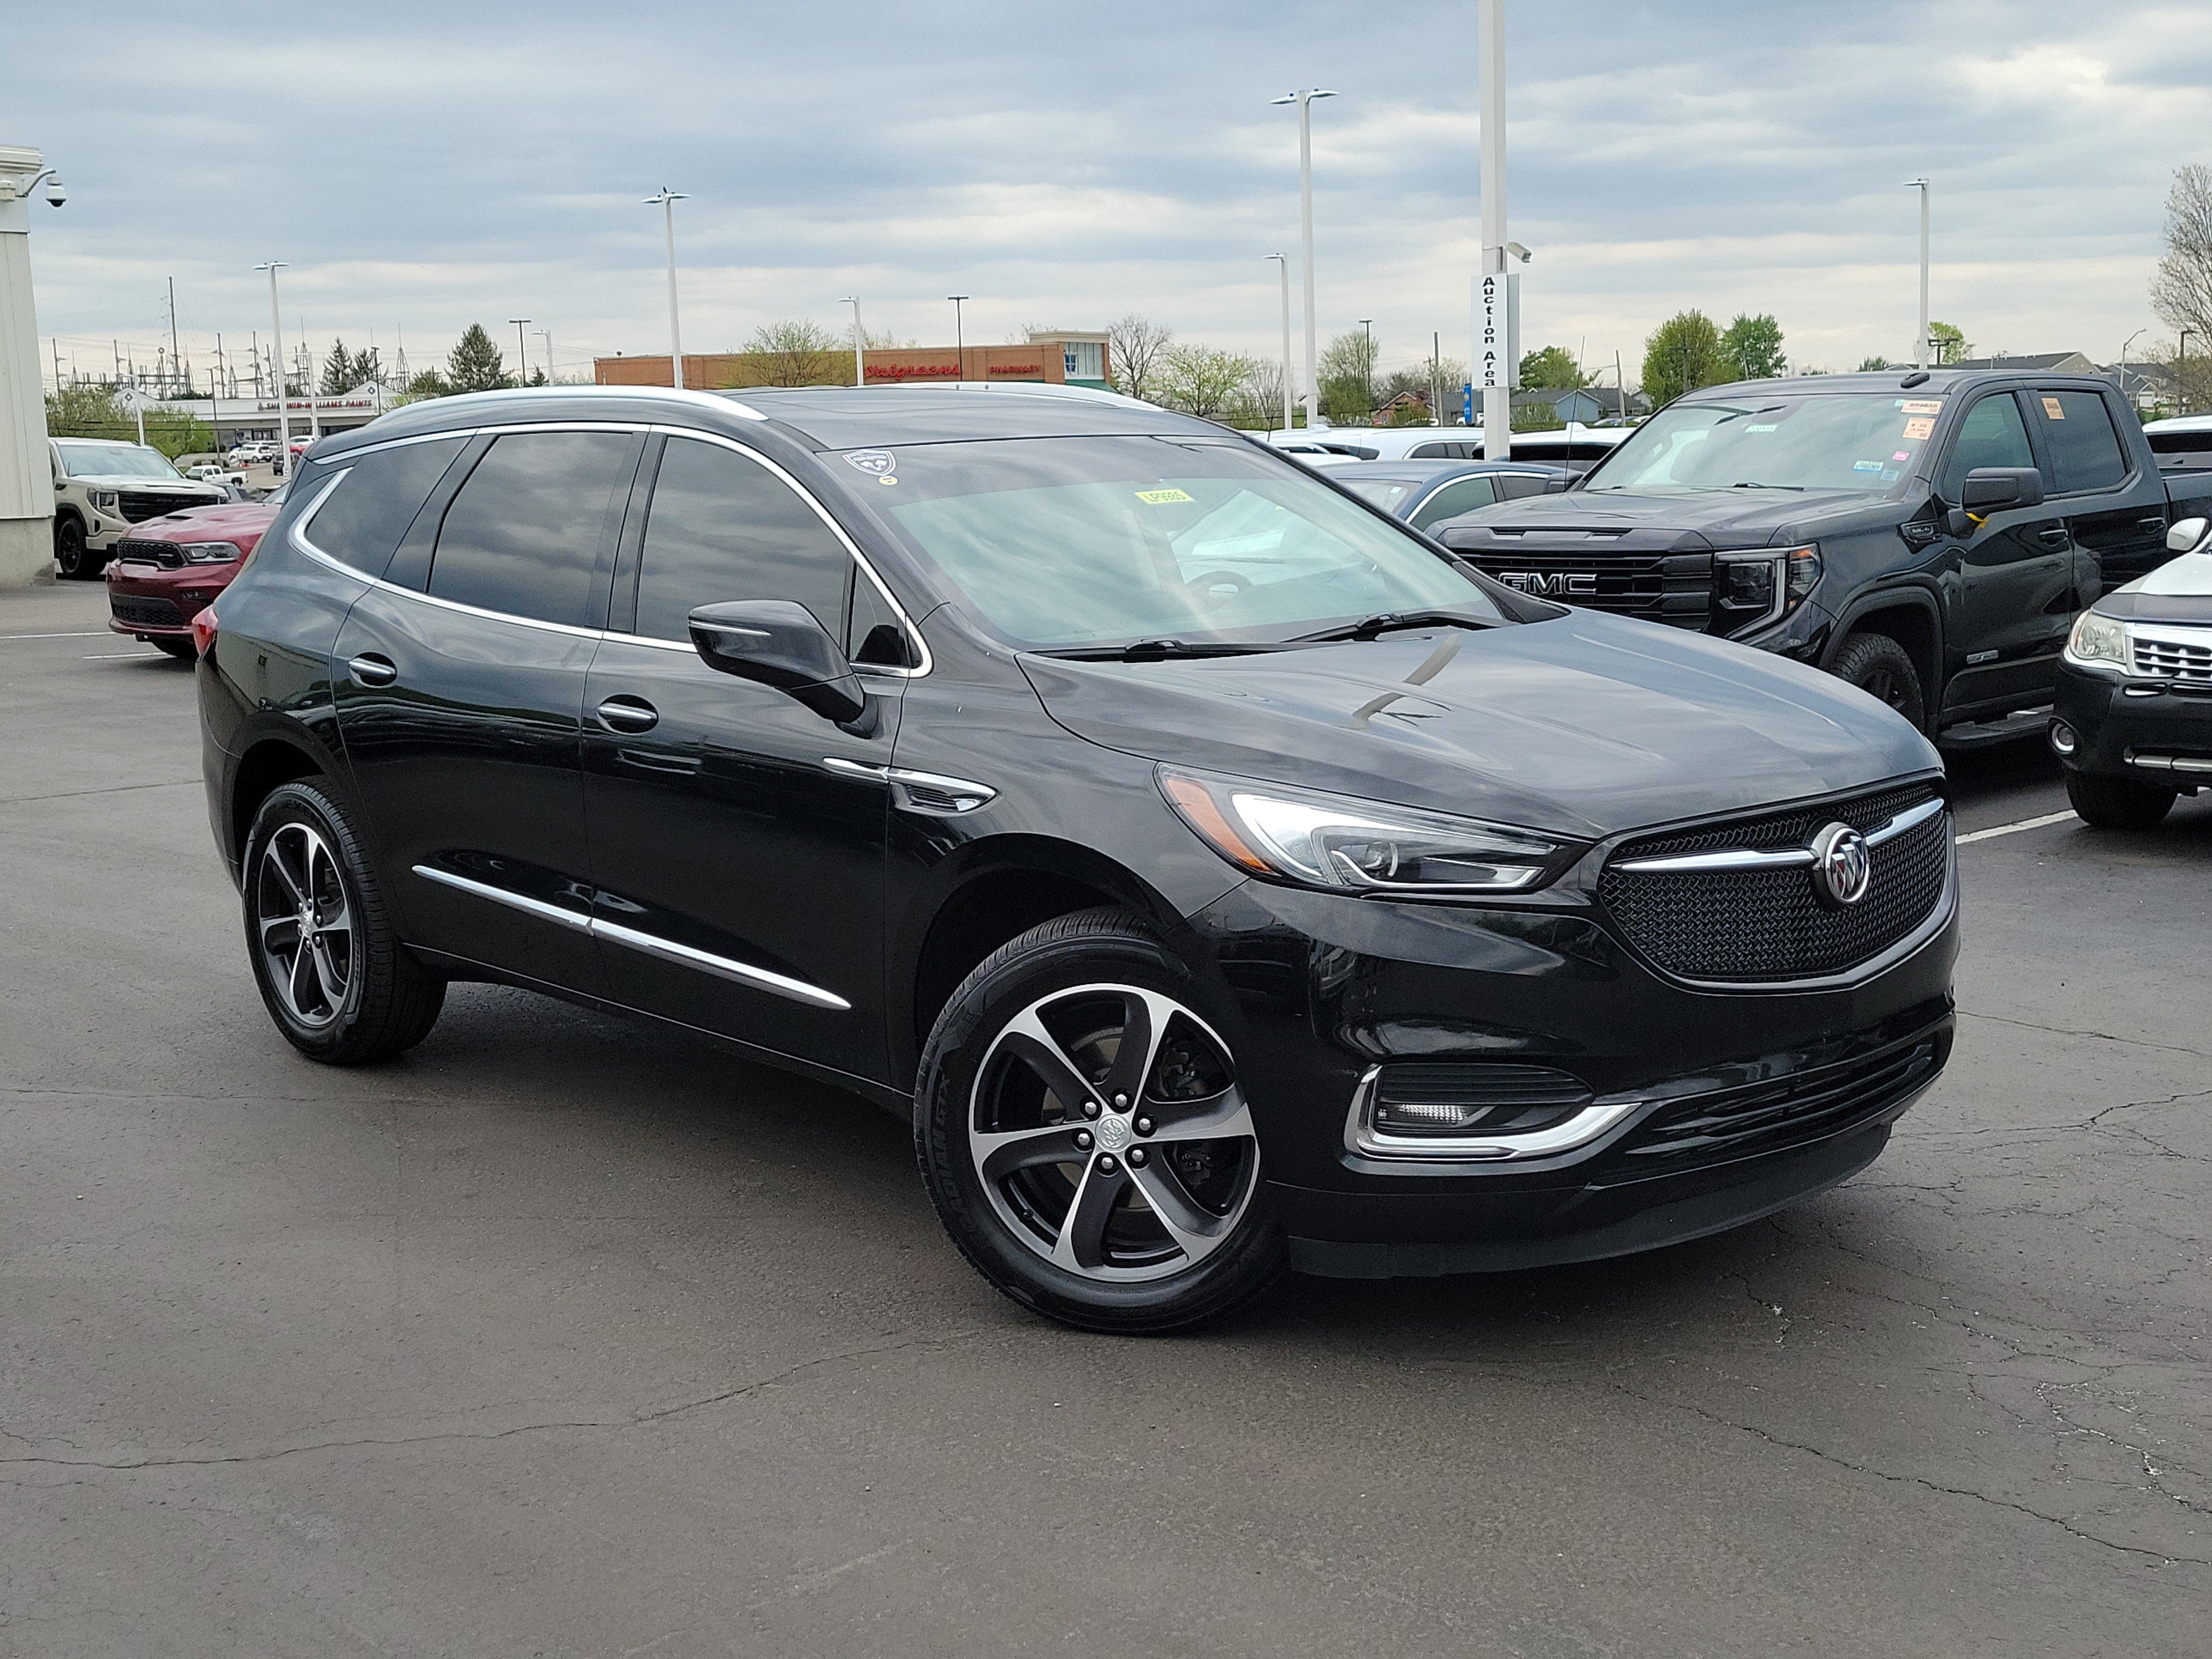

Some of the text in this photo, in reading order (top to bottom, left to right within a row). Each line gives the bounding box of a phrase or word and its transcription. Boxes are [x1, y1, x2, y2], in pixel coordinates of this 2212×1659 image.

[1482, 276, 1496, 386] Auction Area
[1498, 572, 1597, 595] GMC
